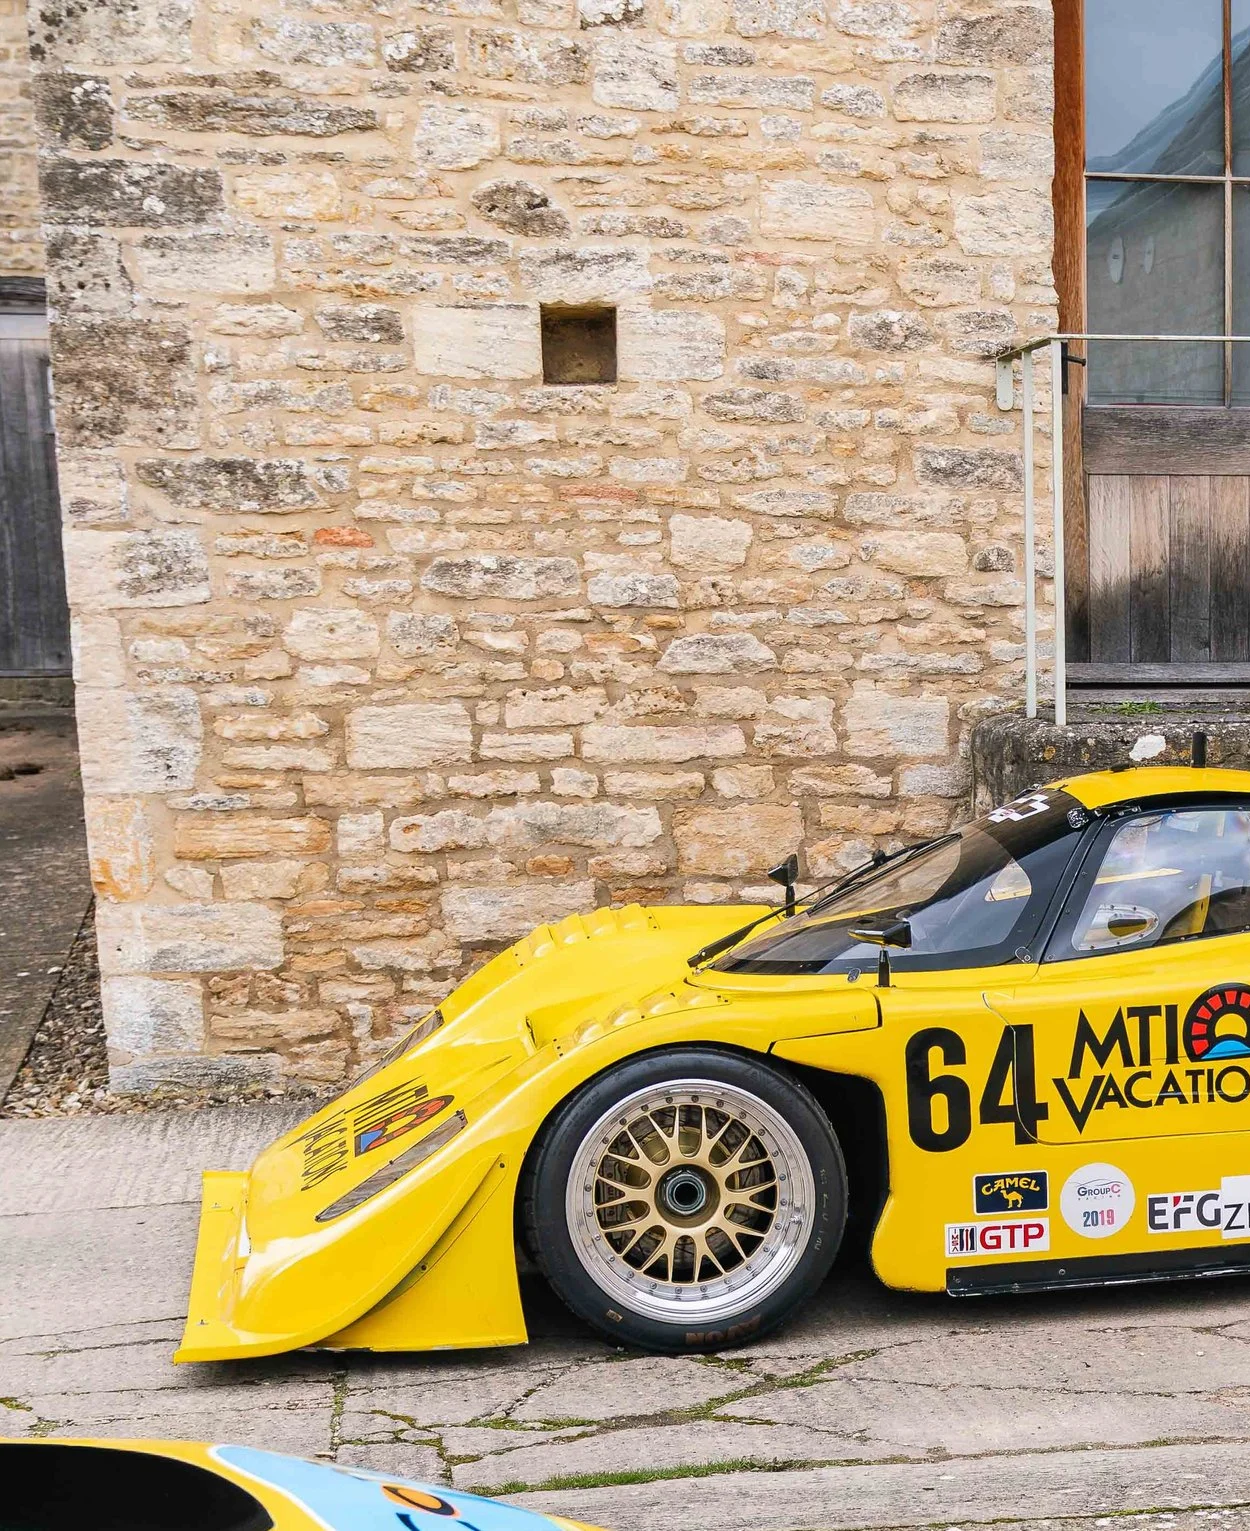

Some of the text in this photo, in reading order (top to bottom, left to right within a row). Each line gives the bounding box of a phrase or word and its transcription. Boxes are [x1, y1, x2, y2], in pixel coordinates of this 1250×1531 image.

[1068, 1003, 1181, 1079] MTI
[904, 1023, 1049, 1153] 64
[981, 1177, 1041, 1196] CAMEL
[1082, 1208, 1115, 1228] 2019
[1148, 1193, 1221, 1231] EFG
[979, 1223, 1045, 1250] GTP
